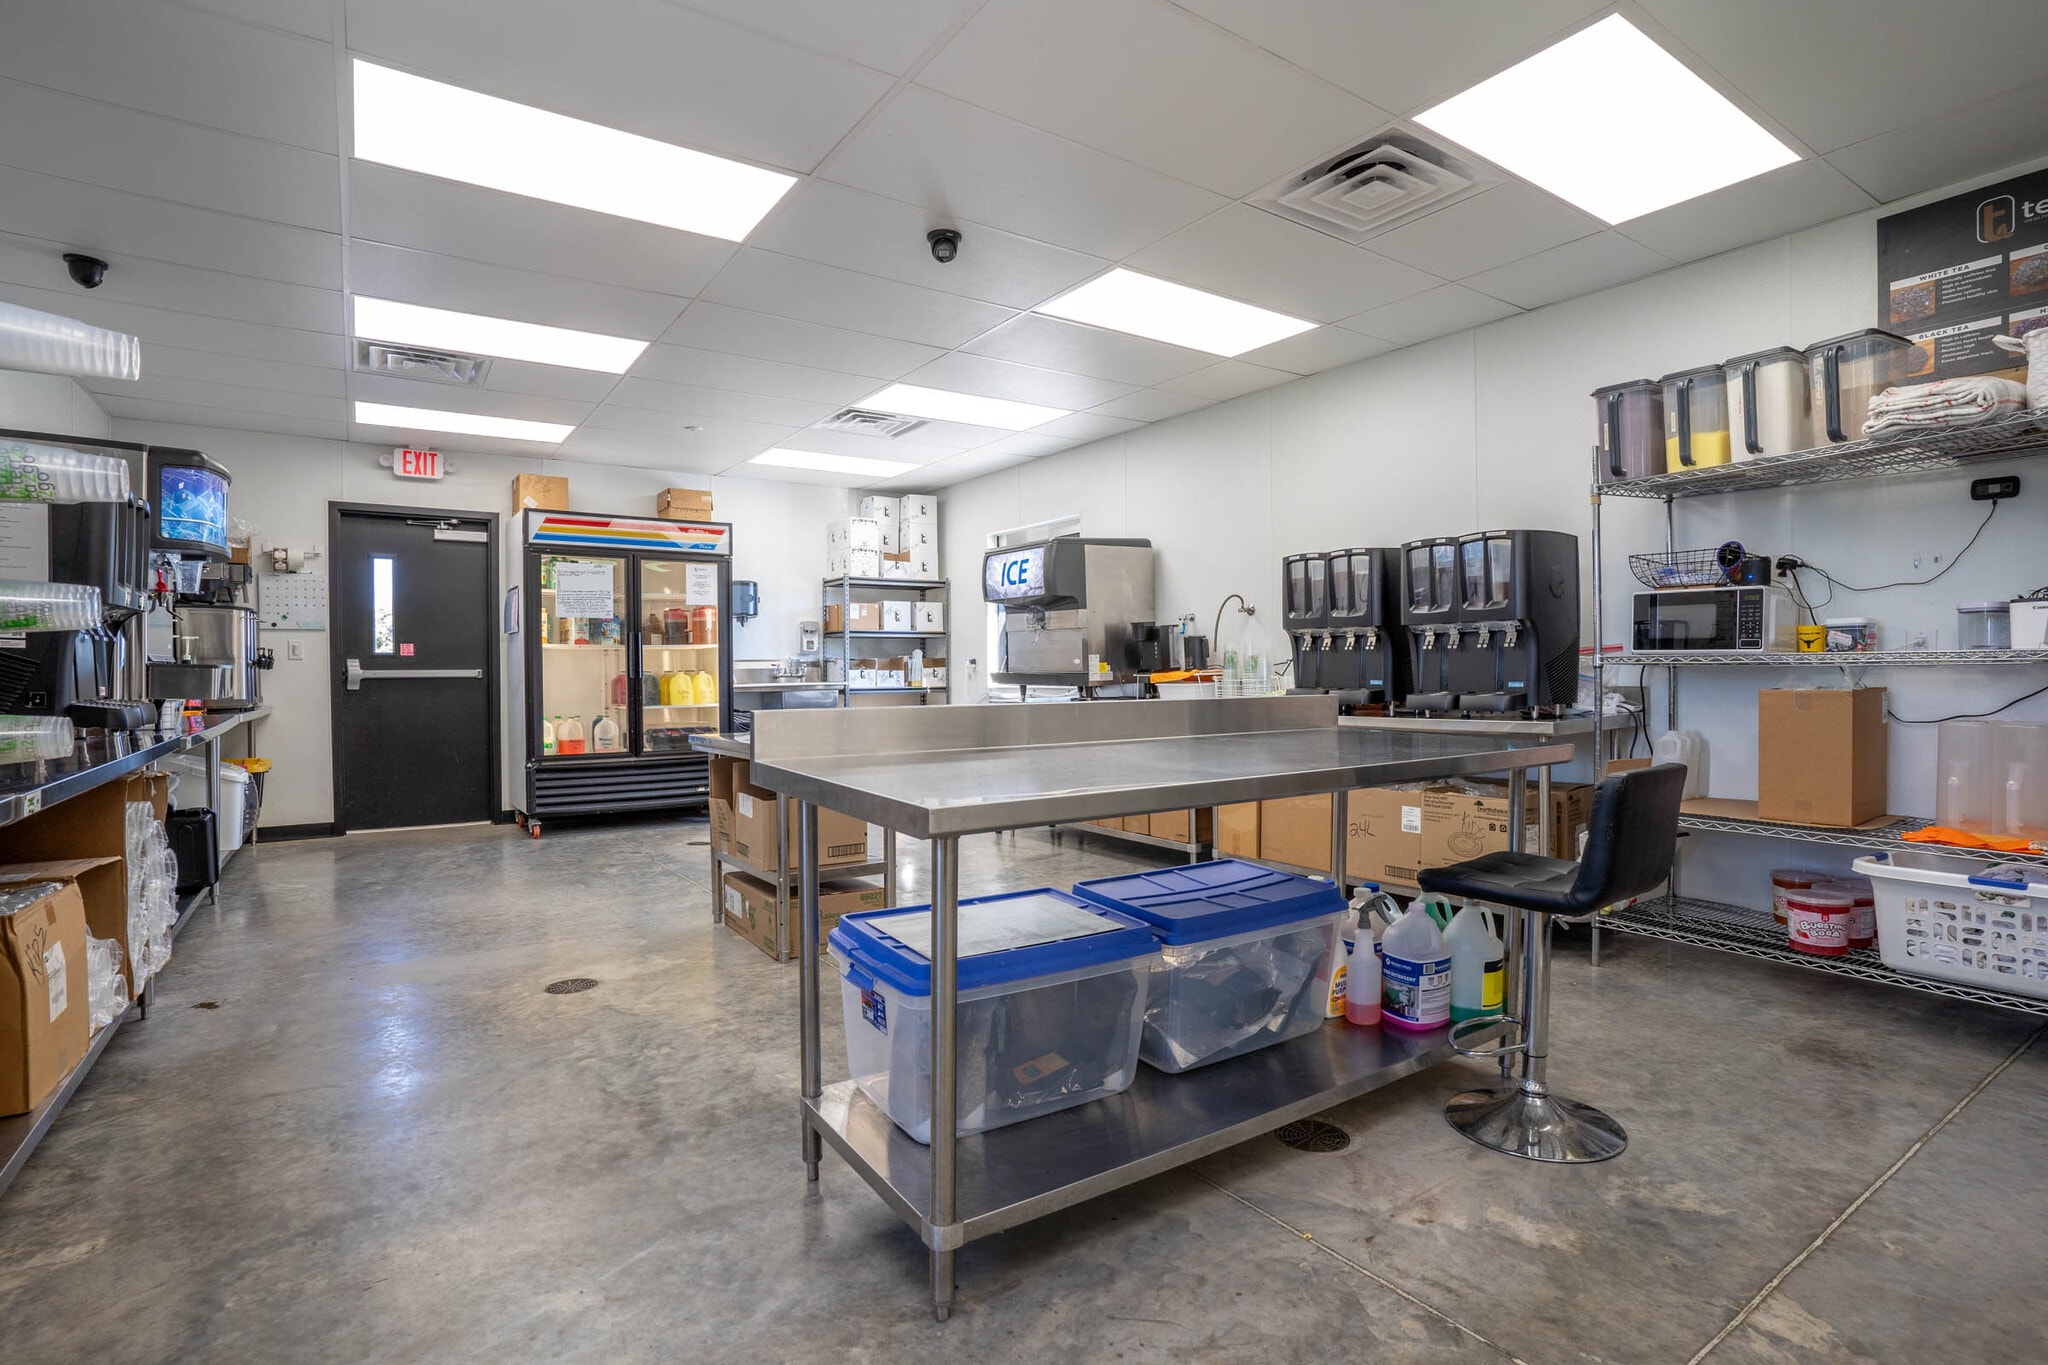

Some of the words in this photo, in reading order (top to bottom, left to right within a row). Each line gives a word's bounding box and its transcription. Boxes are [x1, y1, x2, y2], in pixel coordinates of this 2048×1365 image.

[1919, 270, 1949, 281] WHITE
[1952, 265, 1970, 273] TEA
[1918, 329, 1949, 340] BLACK
[1951, 325, 1970, 333] TEA
[402, 450, 437, 477] EXIT
[1001, 559, 1029, 587] ICE
[1809, 929, 1840, 938] BOBA
